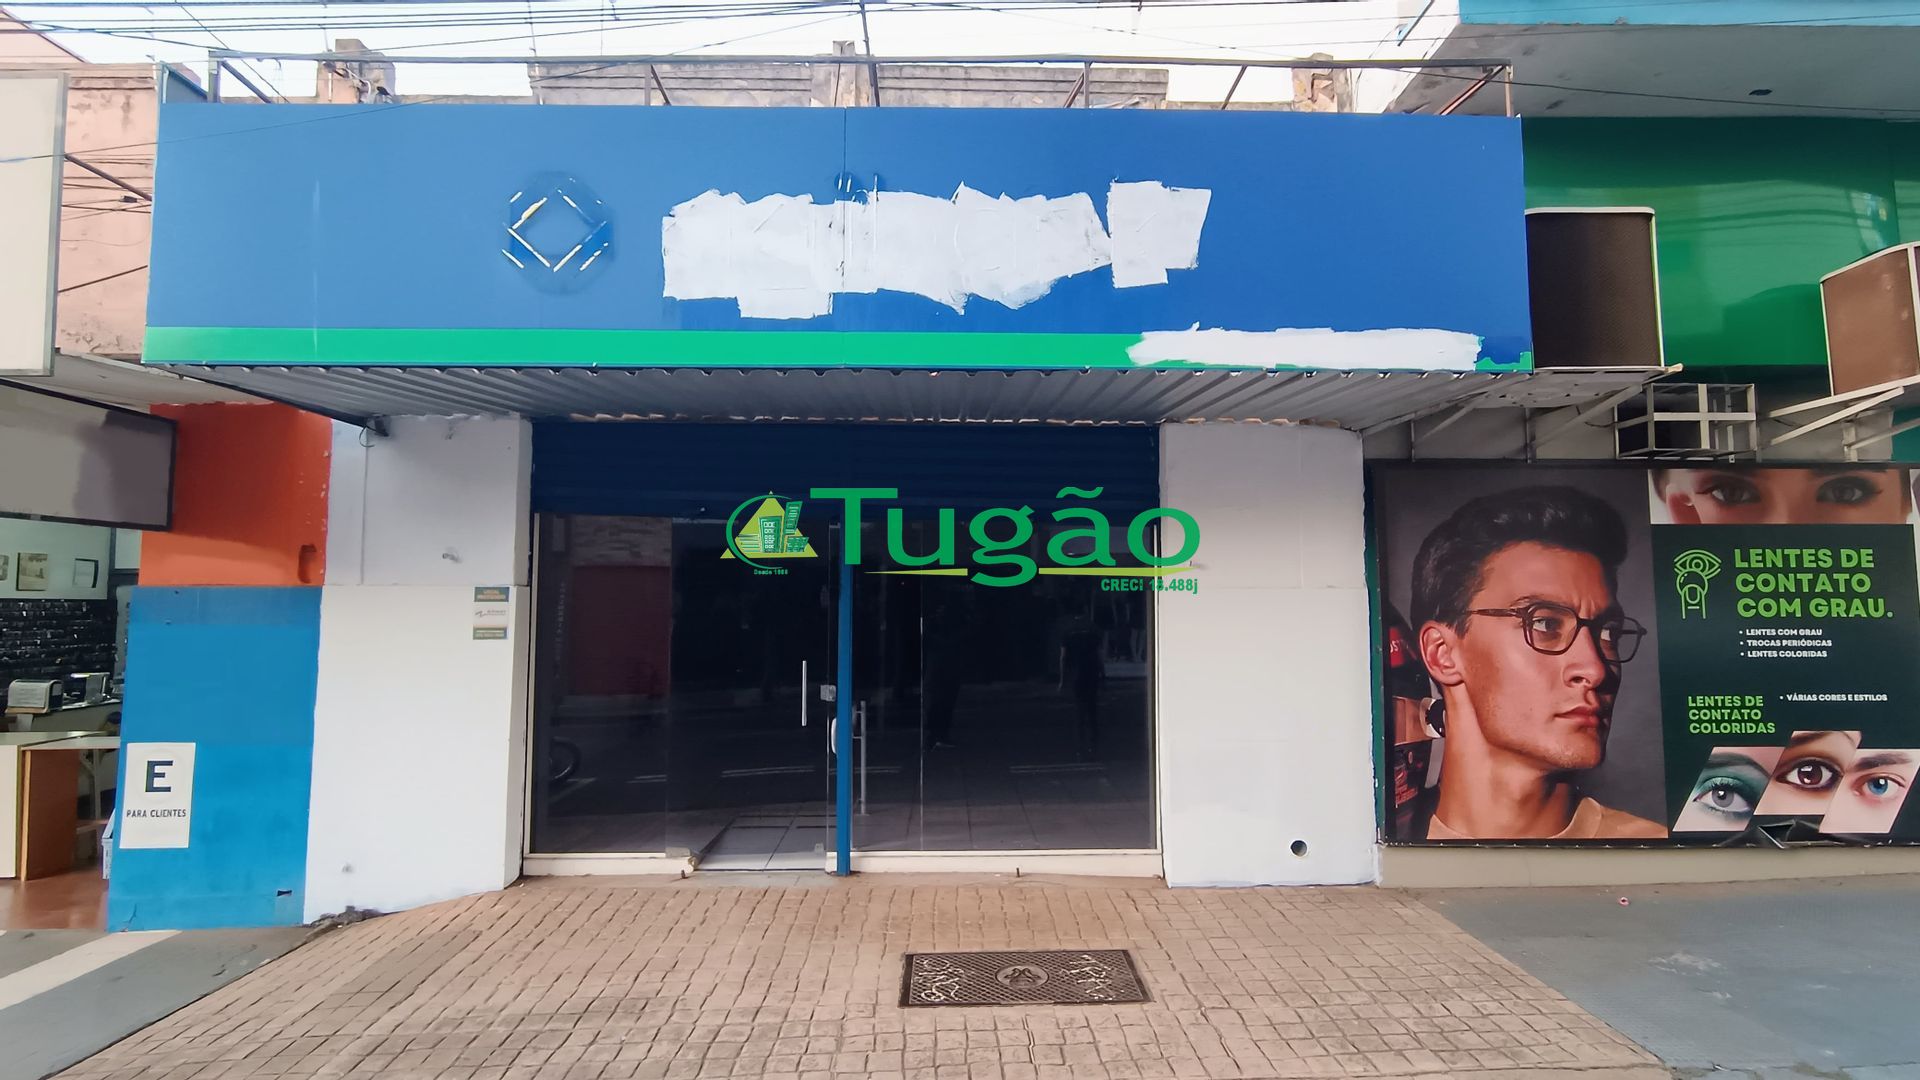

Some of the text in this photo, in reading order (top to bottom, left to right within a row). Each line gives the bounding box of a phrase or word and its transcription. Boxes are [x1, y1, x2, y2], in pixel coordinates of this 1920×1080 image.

[1734, 548, 1875, 568] LENTES DE
[1735, 573, 1872, 593] CONTATO
[1736, 598, 1894, 618] COM GRAU.
[1746, 628, 1823, 636] LENTES COM GRAU
[1747, 637, 1832, 647] TROCAS PERIÓDICAS
[1747, 650, 1828, 658] LENTES COLORIDAS
[1688, 695, 1764, 707] LENTES DE
[1786, 692, 1818, 701] VÁRIAS
[1688, 709, 1762, 721] CONTATO
[1689, 722, 1776, 734] COLORIDAS
[145, 760, 174, 793] E
[126, 808, 187, 818] PARA CLIENTES
